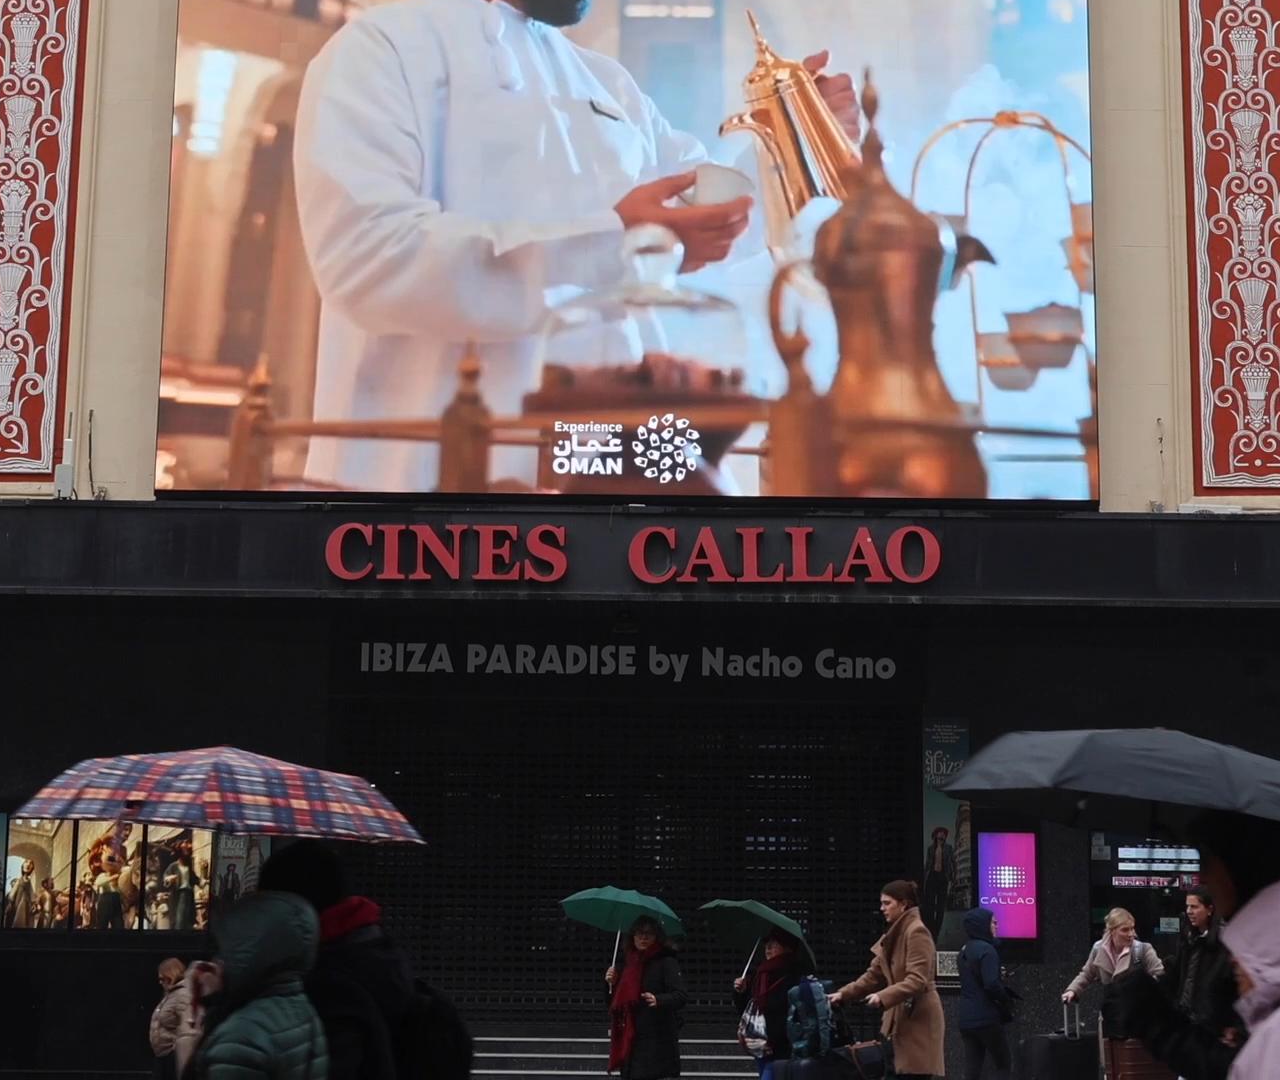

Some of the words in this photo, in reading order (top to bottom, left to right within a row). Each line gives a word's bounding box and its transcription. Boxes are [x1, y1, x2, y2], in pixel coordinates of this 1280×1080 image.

[554, 421, 623, 434] Experience
[552, 457, 623, 475] OMAN
[324, 522, 568, 583] CINES
[627, 525, 941, 585] CALLAO
[360, 642, 453, 673] IBIZA
[466, 643, 636, 675] PARADISE
[648, 642, 688, 682] by
[700, 647, 803, 678] Nacho
[814, 648, 897, 679] Cano
[980, 897, 1035, 905] CALLAO
